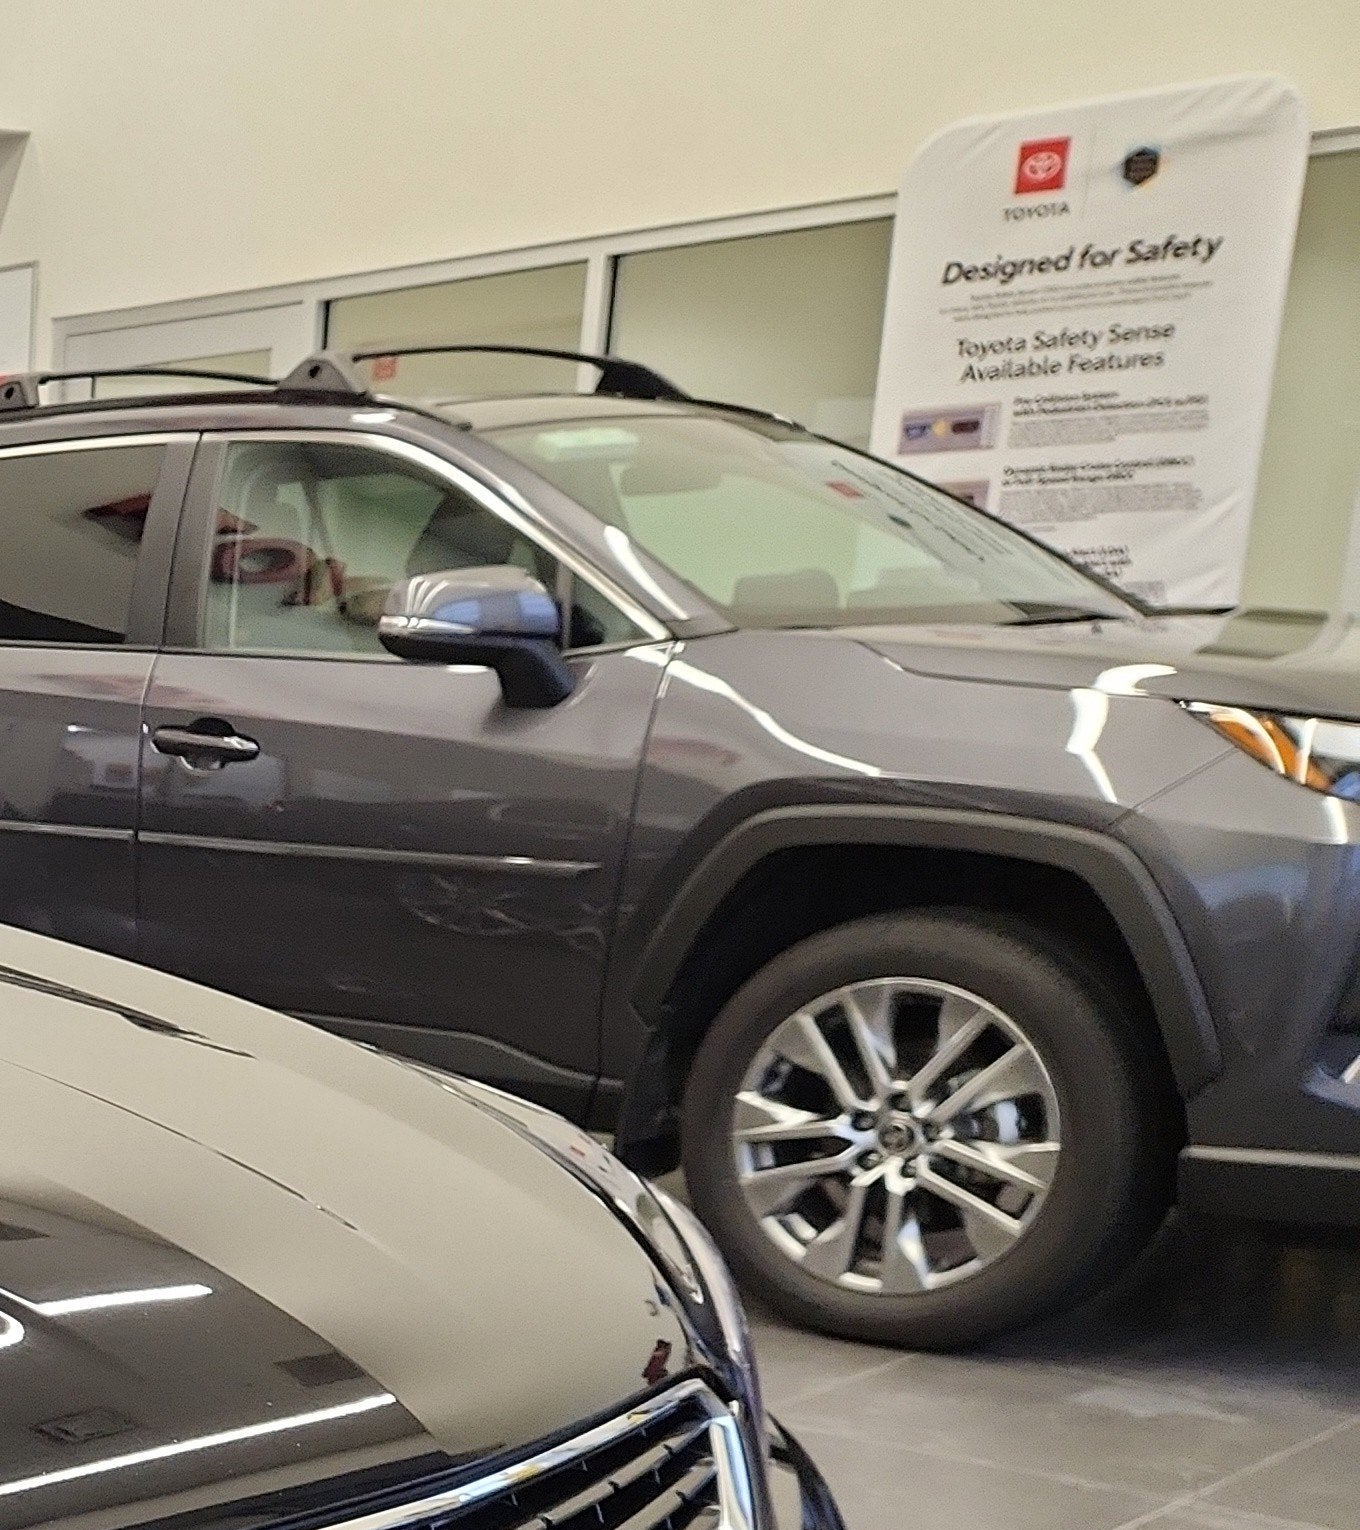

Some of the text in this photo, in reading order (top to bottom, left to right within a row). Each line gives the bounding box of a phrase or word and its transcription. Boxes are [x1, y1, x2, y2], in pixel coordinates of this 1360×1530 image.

[1002, 201, 1070, 221] TOYOTA
[941, 234, 1224, 284] Designed for Safety
[957, 323, 1176, 360] Toyota Safety Sense
[960, 351, 1165, 383] Available Features
